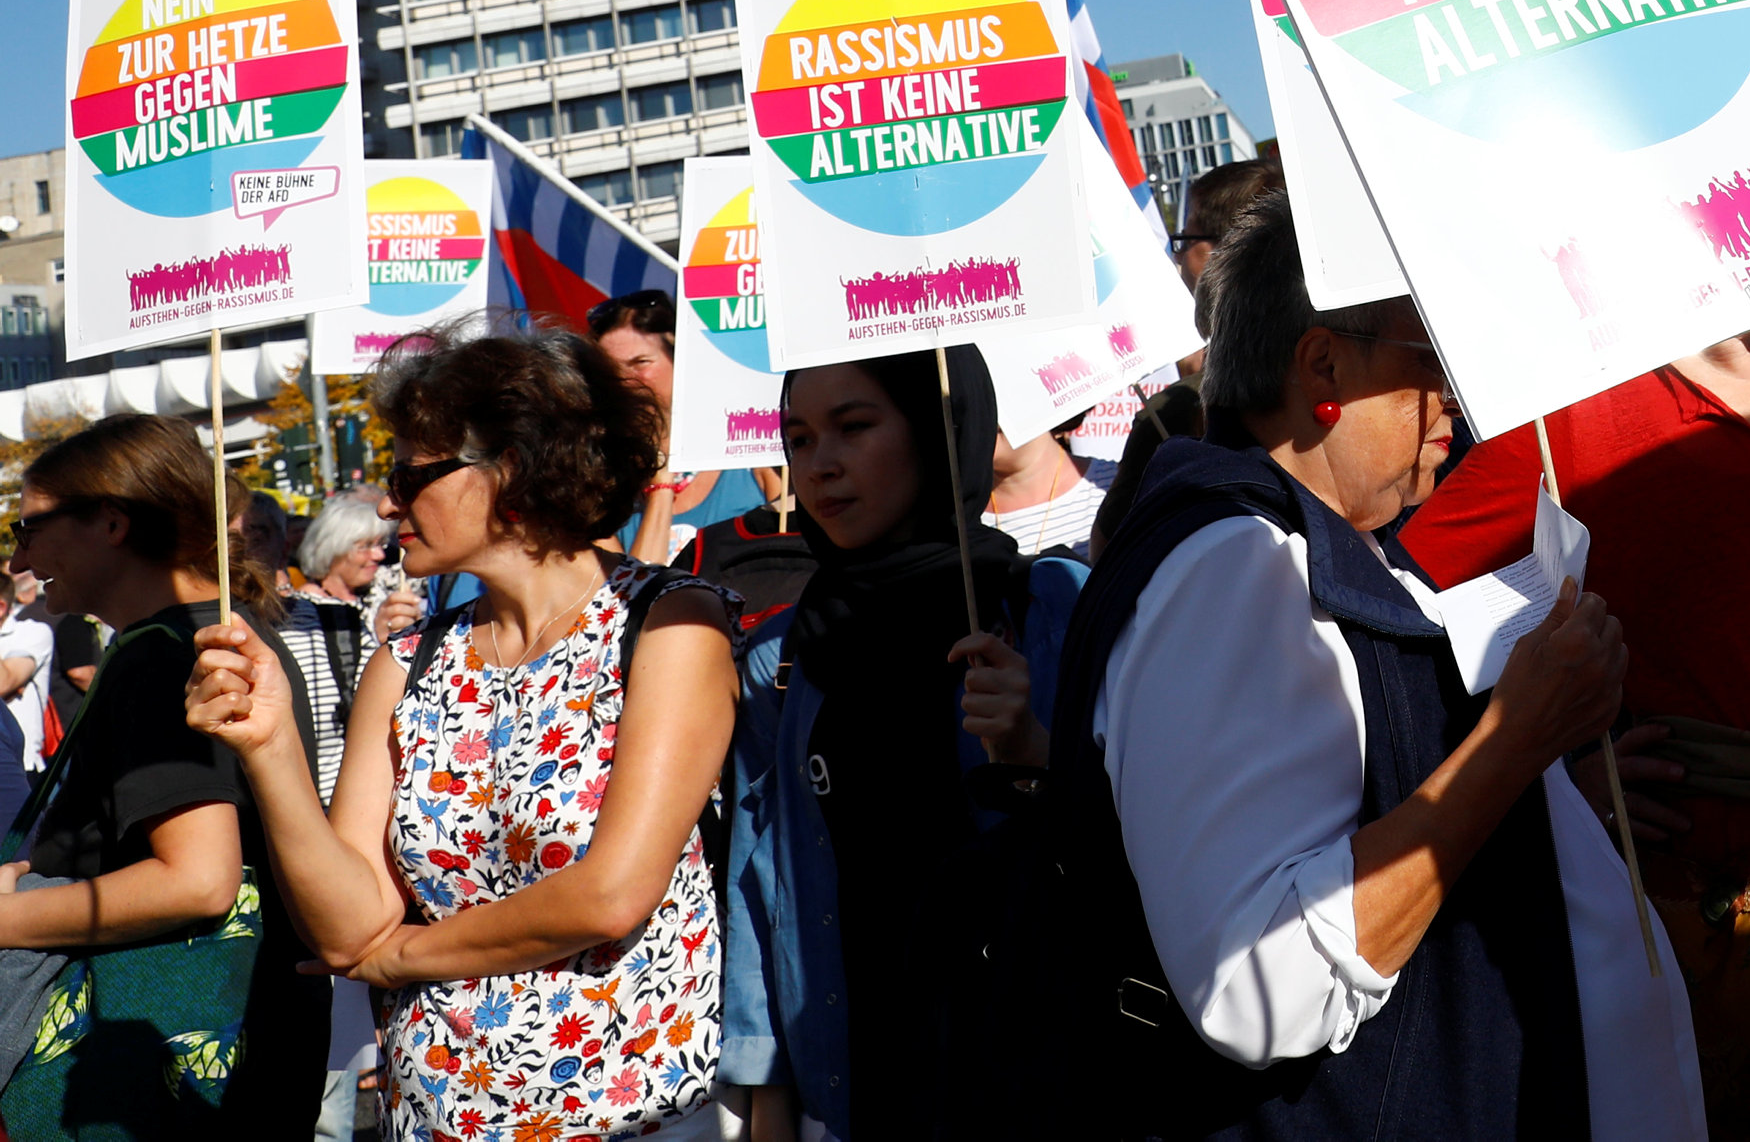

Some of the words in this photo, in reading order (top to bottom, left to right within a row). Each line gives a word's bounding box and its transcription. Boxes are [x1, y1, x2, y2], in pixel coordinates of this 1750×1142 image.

[117, 34, 175, 84] ZUR
[187, 13, 288, 65] HETZE
[789, 14, 1005, 80] RASSISMUS
[134, 62, 238, 125] GEGEN
[808, 81, 866, 130] IST
[882, 68, 981, 119] KEINE
[115, 98, 273, 172] MUSLIME
[809, 108, 1043, 178] ALTERNATIVE
[239, 176, 271, 190] KEINE
[276, 173, 315, 188] BÜHNE
[242, 190, 263, 204] DER
[268, 190, 289, 202] AFD
[367, 214, 457, 236] SSISMUS
[388, 238, 441, 260] KEINE
[368, 261, 468, 283] TERNATIVE
[129, 286, 295, 330] AUFSTEHEN-GEGEN-RASSISMUS.DE
[719, 296, 766, 330] MU
[847, 302, 1028, 342] AUFSTEHEN-GEGEN-RASSISMUS.DE
